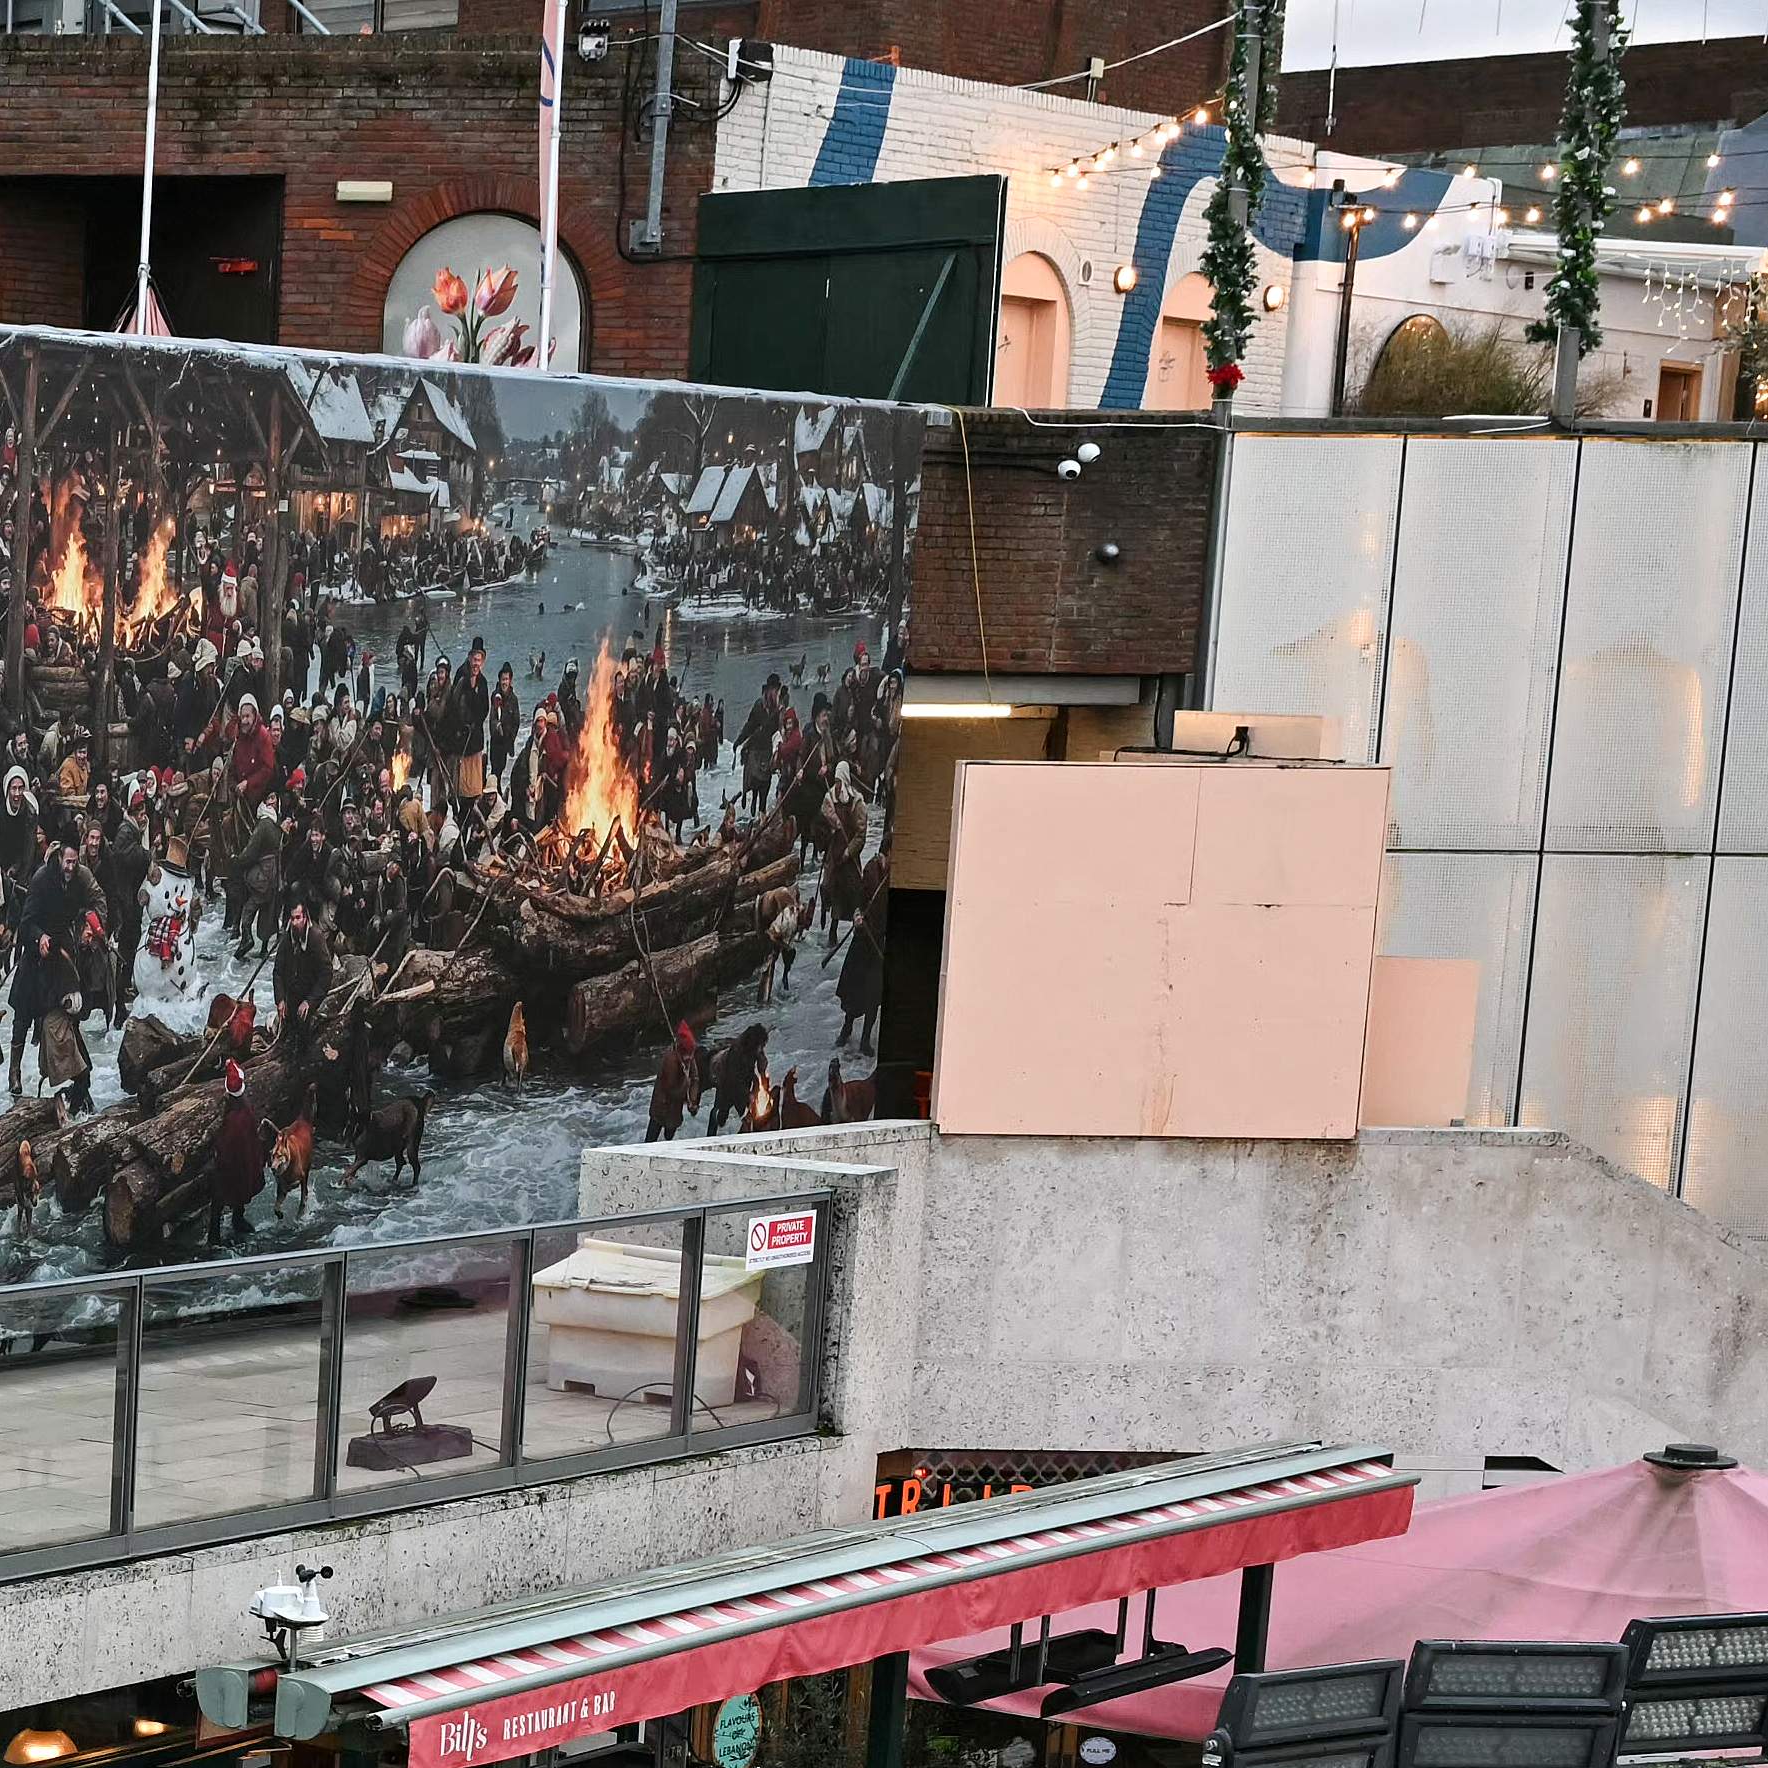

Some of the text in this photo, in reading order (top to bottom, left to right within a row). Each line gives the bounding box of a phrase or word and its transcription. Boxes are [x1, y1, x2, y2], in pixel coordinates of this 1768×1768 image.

[777, 1220, 805, 1233] PRIVATE
[771, 1232, 808, 1246] PROPERTY
[440, 1690, 616, 1761] Bill's RESTAURANT & BAR
